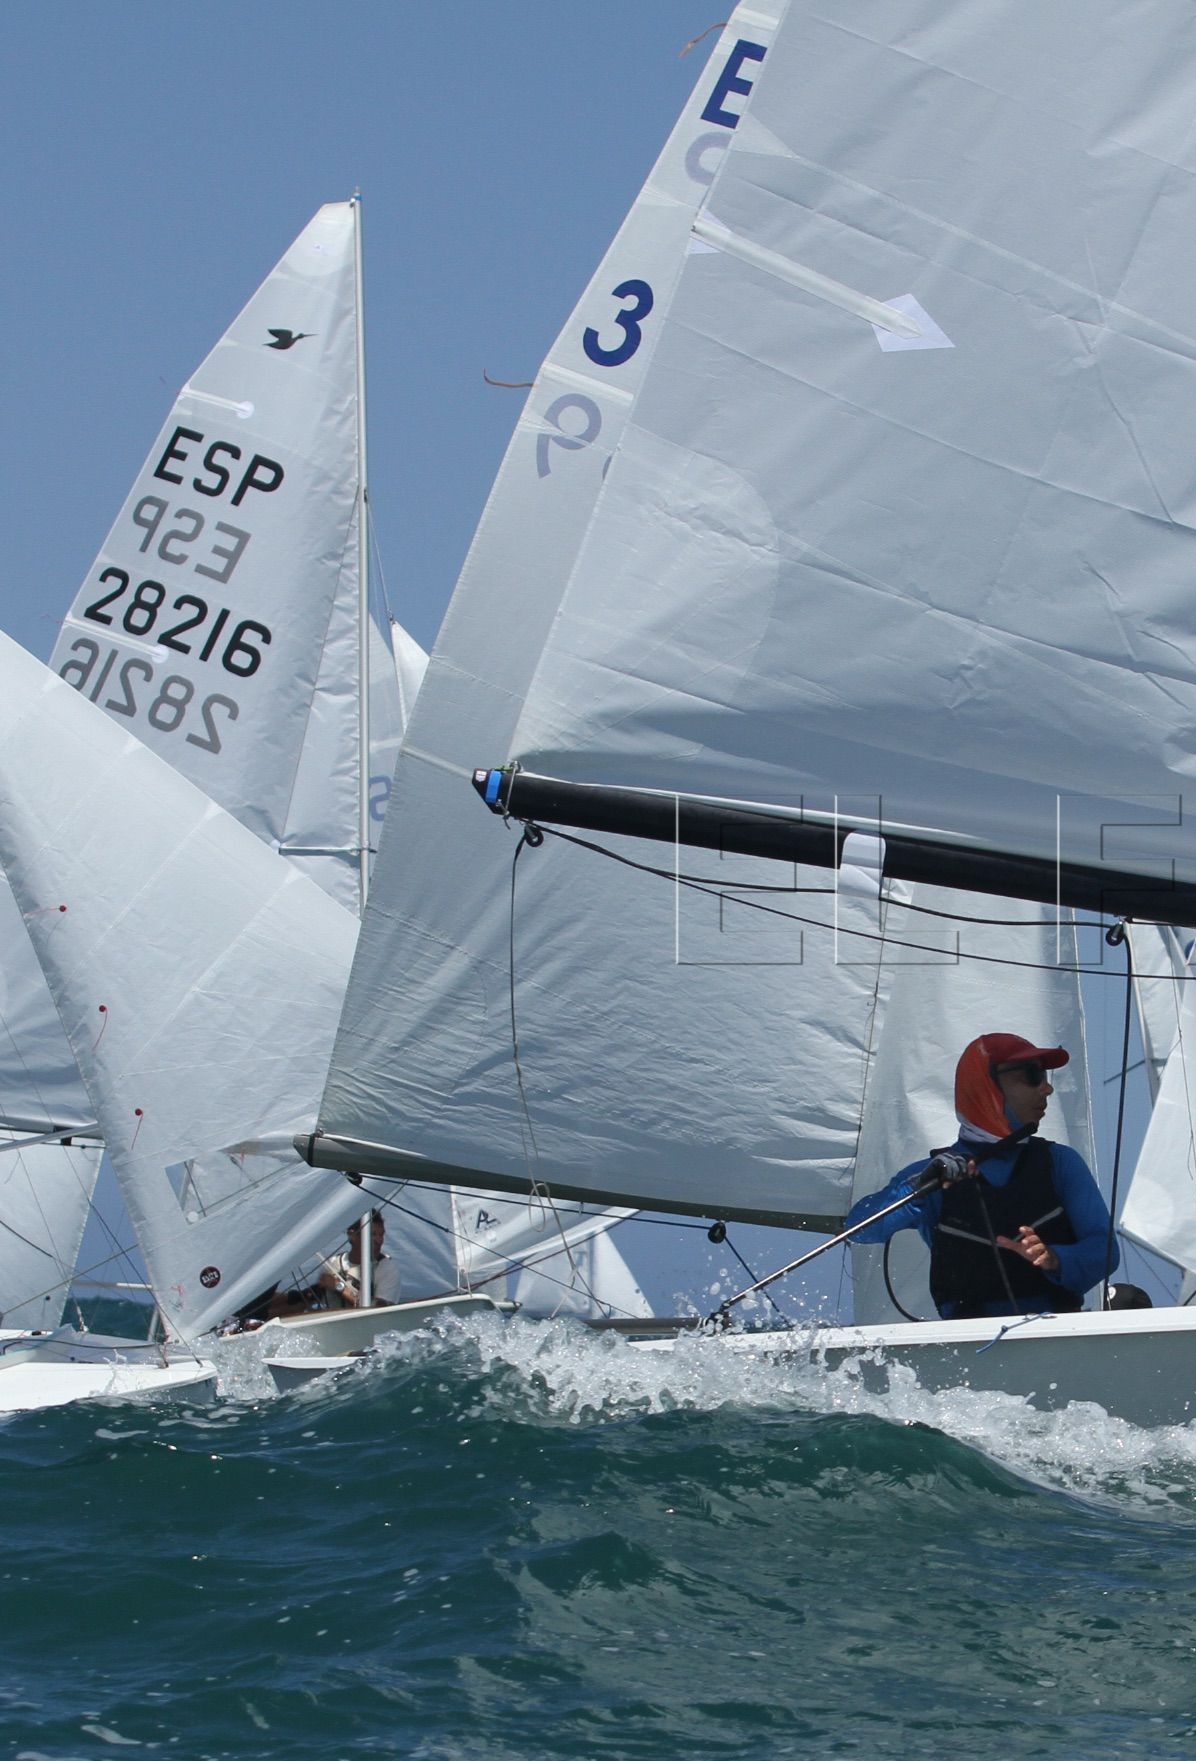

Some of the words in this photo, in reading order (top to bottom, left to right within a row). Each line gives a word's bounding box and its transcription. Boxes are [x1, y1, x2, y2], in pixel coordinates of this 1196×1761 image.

[582, 278, 655, 368] 3
[153, 425, 285, 507] ESP
[83, 566, 272, 678] 28216
